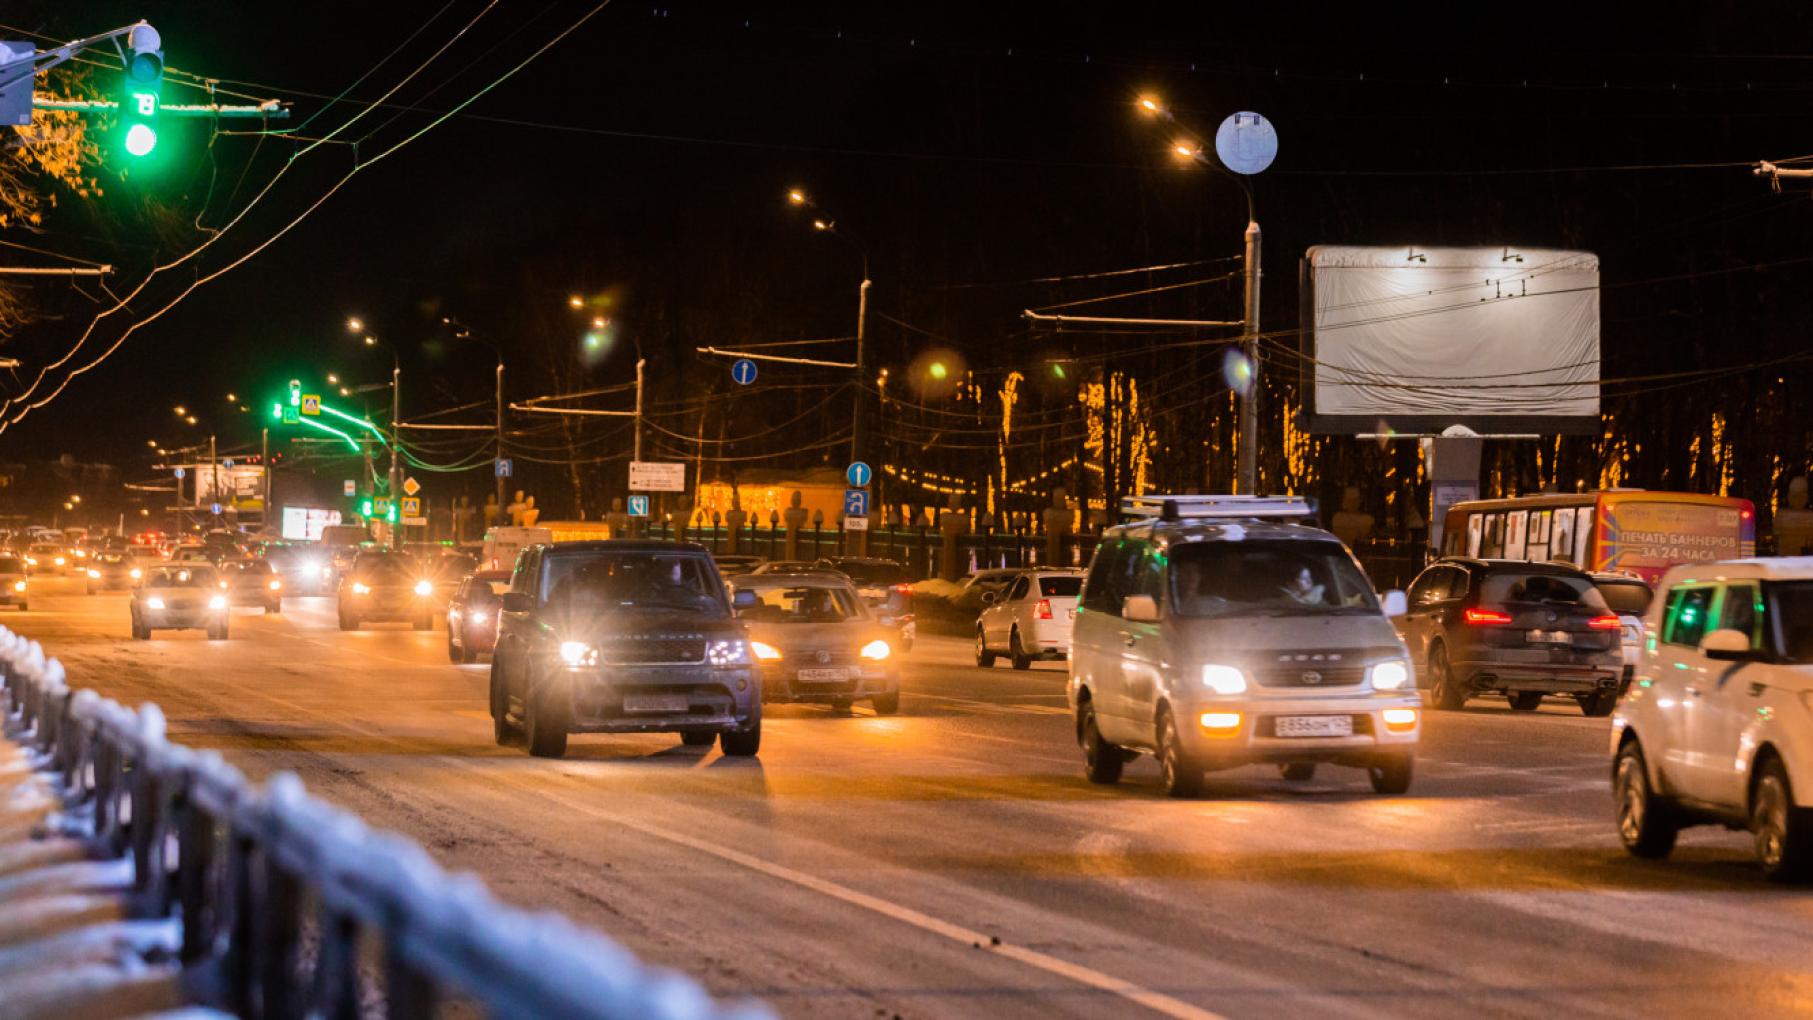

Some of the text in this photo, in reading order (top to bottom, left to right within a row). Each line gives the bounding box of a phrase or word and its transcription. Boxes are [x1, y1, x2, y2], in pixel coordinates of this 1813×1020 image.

[1622, 532, 1737, 548] ПЕЧАТЬ БАННЕРОВ
[1641, 547, 1716, 561] ЗА 24 ЧАСА
